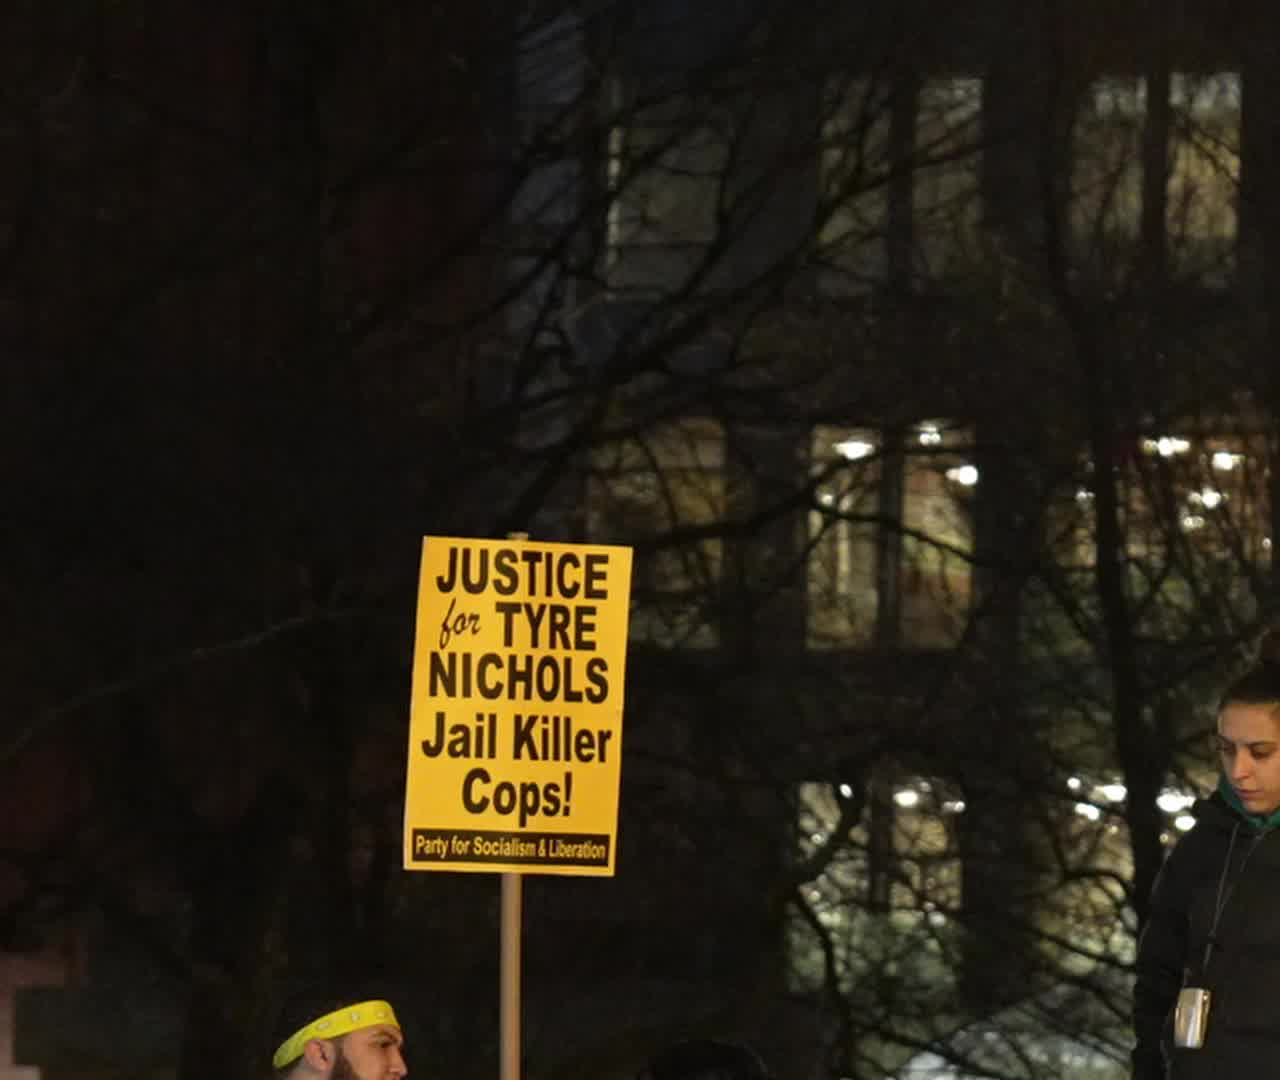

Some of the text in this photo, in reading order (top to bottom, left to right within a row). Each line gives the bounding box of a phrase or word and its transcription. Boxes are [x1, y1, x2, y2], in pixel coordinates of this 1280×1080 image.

[436, 547, 609, 600] JUSTICE
[439, 598, 596, 651] for TYRE
[428, 651, 609, 704] NICHOLS
[421, 712, 612, 763] Jail Killer
[462, 768, 573, 828] Cops!
[415, 835, 606, 860] Party for Socialism & Liberation
